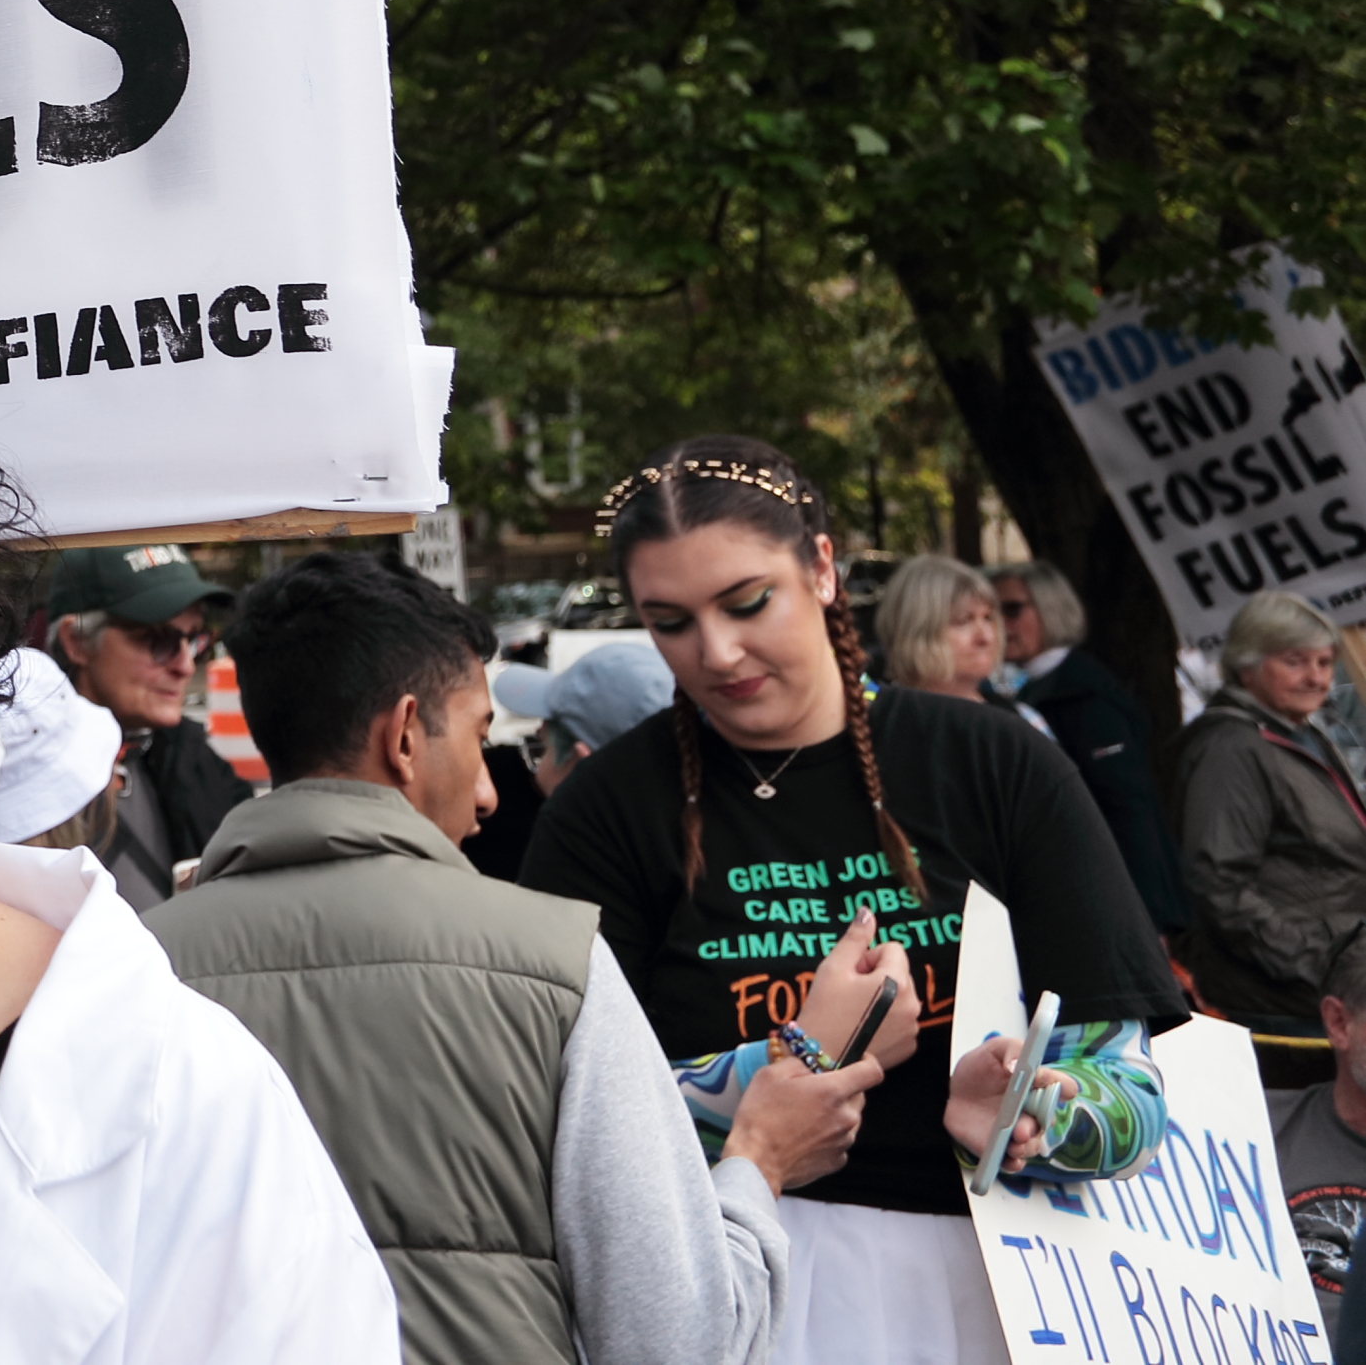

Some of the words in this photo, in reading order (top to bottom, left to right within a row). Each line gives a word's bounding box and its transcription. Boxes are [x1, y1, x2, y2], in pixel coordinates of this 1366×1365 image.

[1121, 369, 1252, 459] END
[1127, 422, 1348, 542] FOSSIL
[1174, 496, 1366, 609] FUELS
[727, 860, 830, 893] GREEN
[744, 897, 831, 925] CARE
[838, 886, 921, 923] JOBS
[698, 931, 837, 960] CLIMATE
